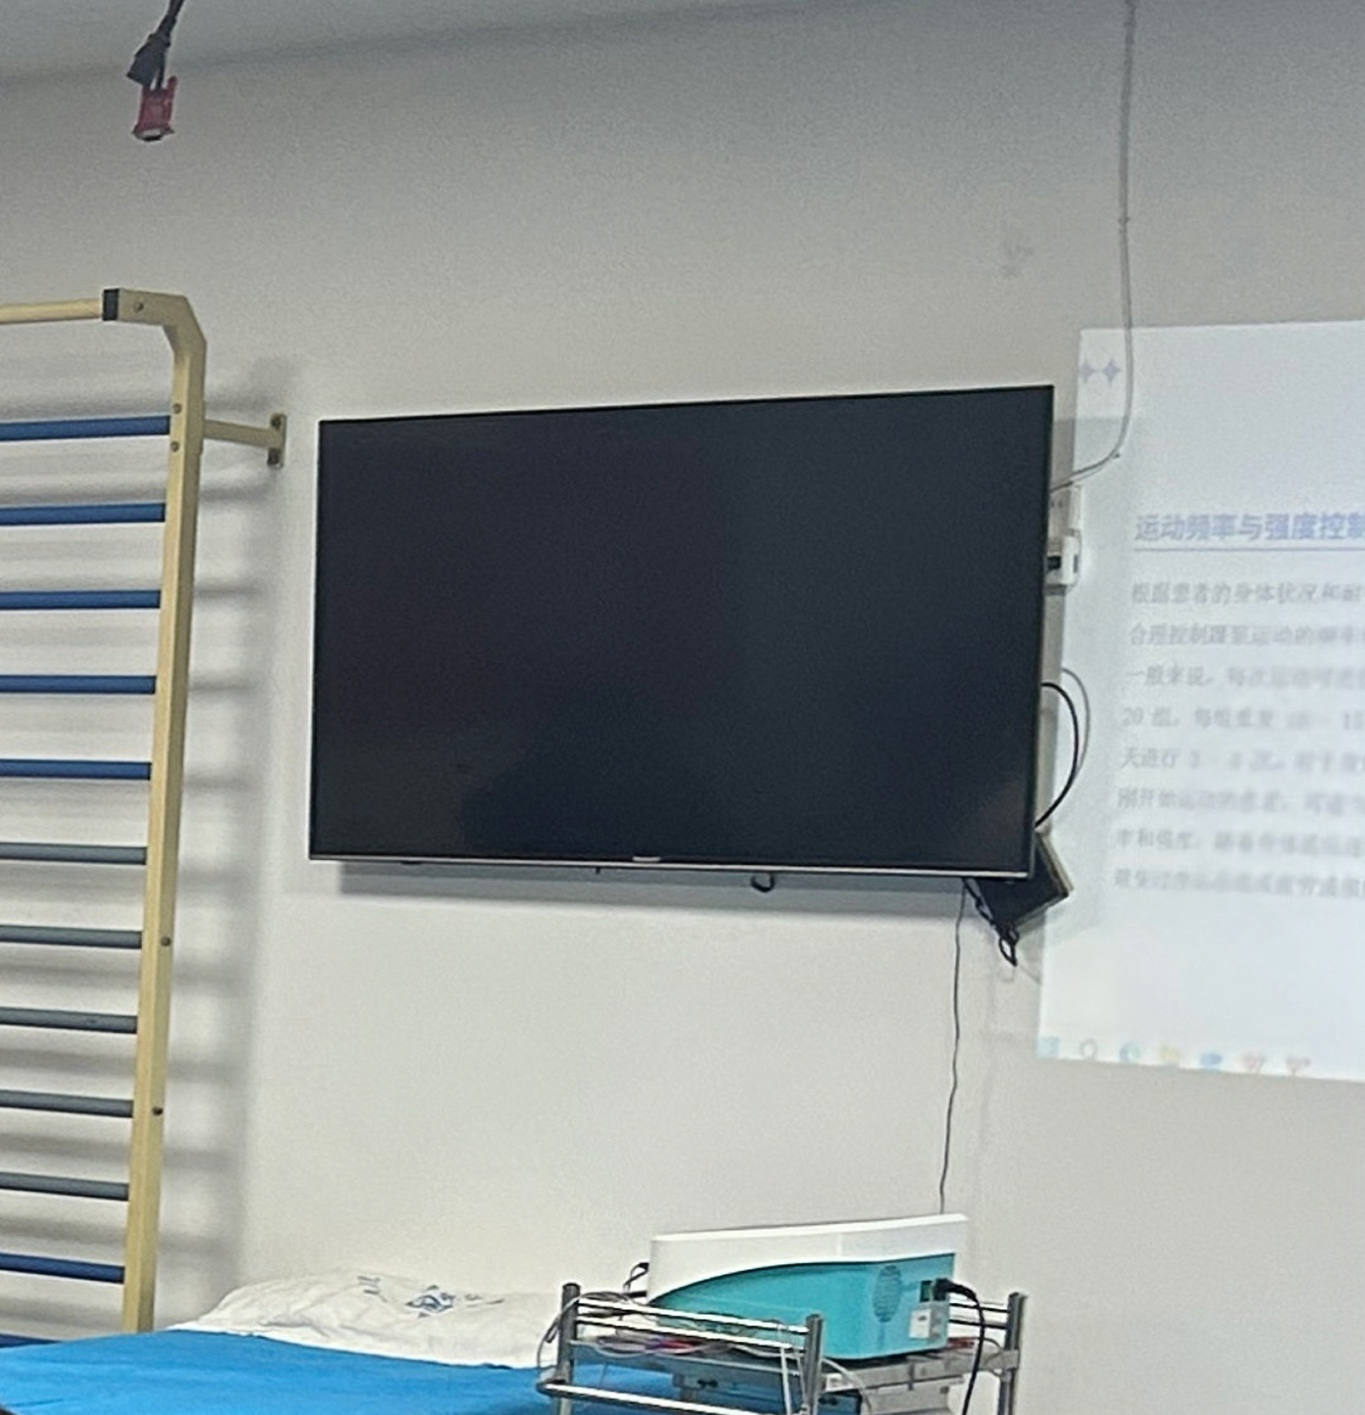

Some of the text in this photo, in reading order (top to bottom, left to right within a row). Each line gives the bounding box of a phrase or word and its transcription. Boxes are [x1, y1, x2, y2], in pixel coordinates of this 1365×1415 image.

[1135, 513, 1365, 541] 运动频率与强度控制
